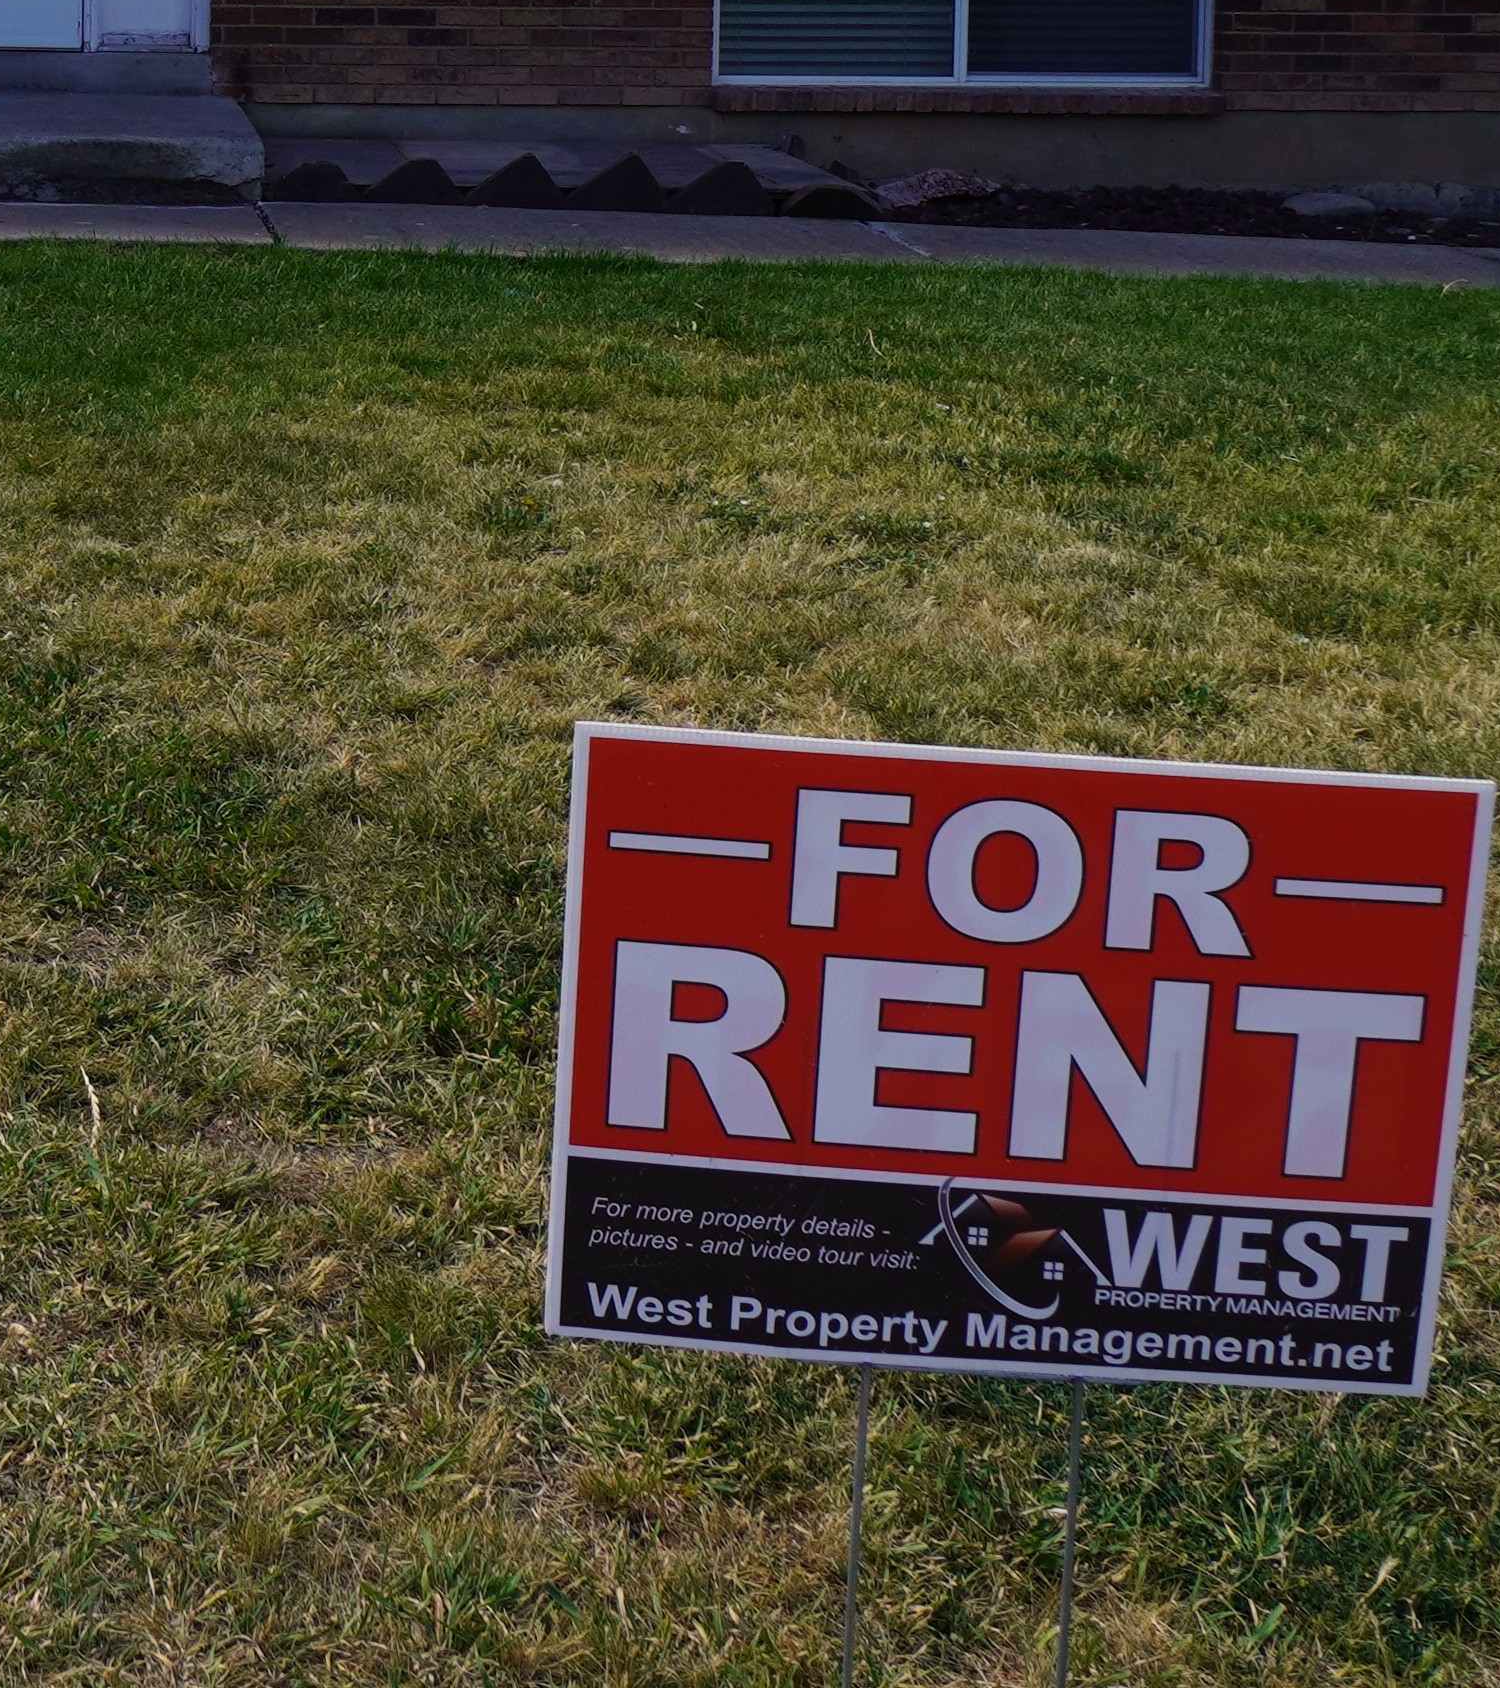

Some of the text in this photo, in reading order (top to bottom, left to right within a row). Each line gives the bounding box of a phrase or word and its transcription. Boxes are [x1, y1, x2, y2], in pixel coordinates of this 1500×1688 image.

[789, 788, 1252, 958] FOR
[606, 940, 1428, 1180] RENT
[588, 1227, 679, 1251] pictures
[700, 1237, 745, 1257] and
[750, 1241, 812, 1263] video
[817, 1244, 865, 1267] tour
[869, 1250, 921, 1271] visit:
[591, 1196, 632, 1218] For
[636, 1203, 694, 1224] more
[699, 1209, 796, 1237] property
[801, 1215, 876, 1239] details
[1103, 1208, 1410, 1303] WEST
[586, 1281, 1396, 1373] West Property Management.net
[1094, 1288, 1400, 1324] PROPERTY MANAGEMENT
